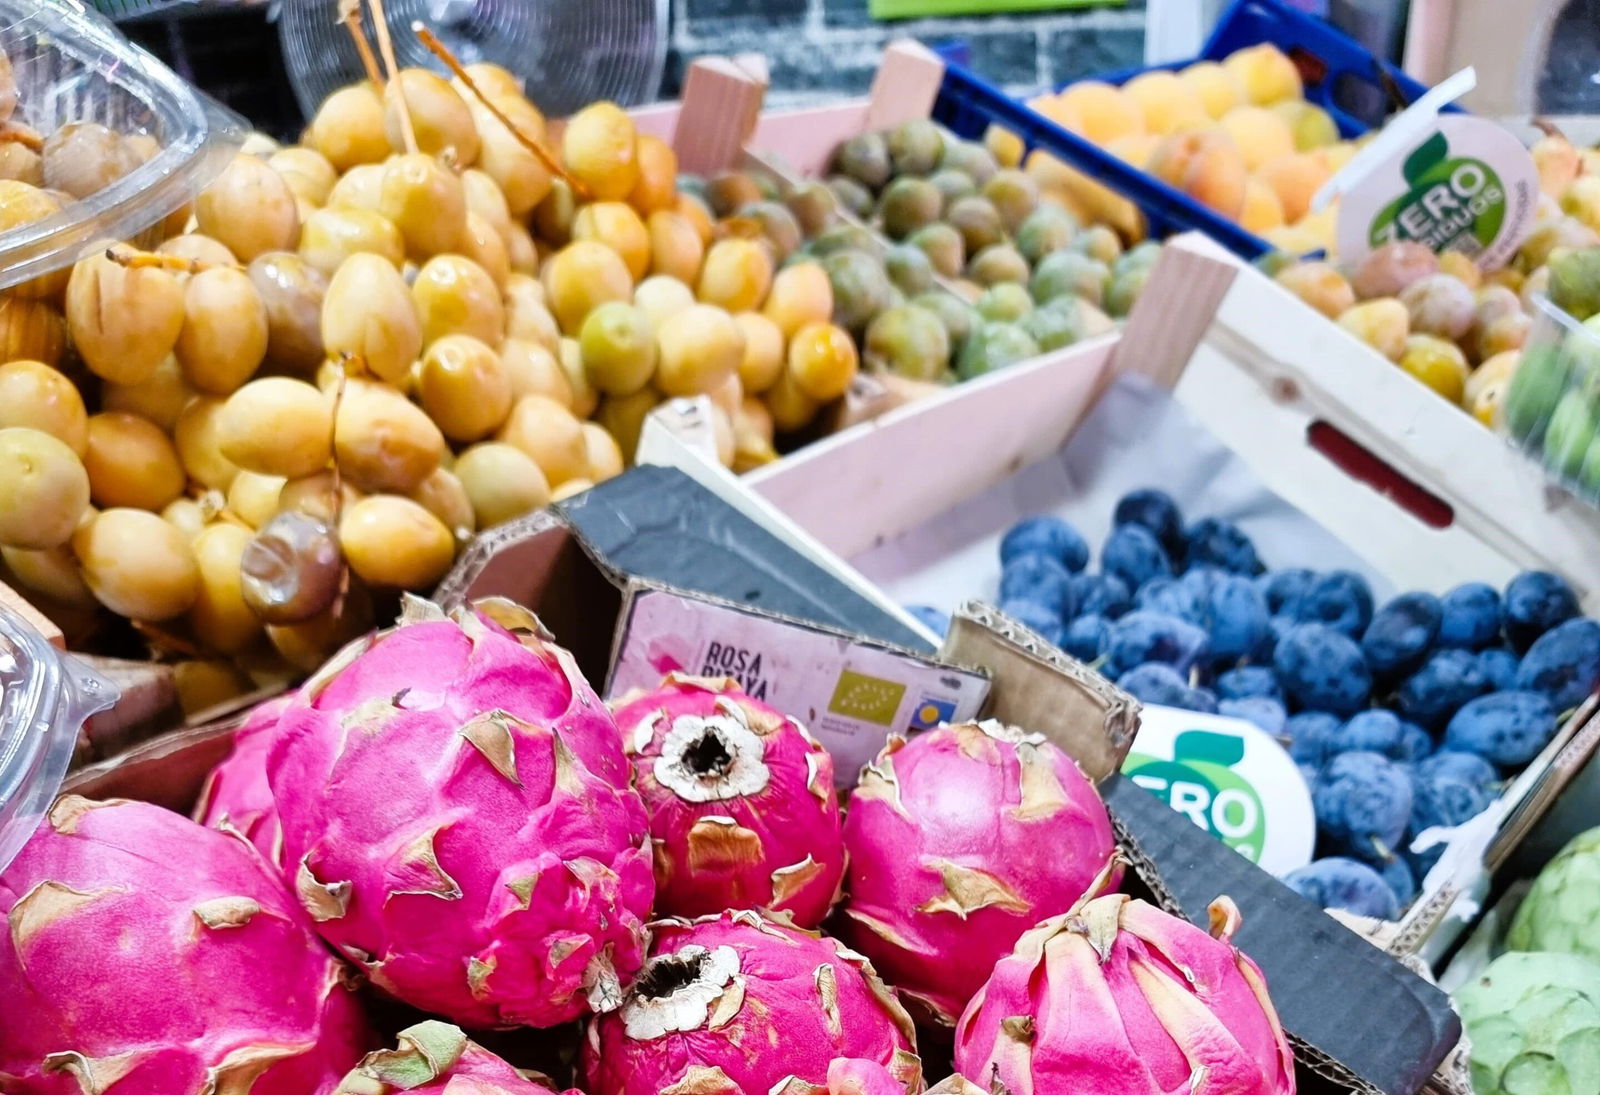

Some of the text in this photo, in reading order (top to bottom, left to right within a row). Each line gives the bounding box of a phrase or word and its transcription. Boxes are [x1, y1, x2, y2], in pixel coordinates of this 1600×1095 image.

[706, 641, 762, 677] ROSA
[701, 665, 767, 702] PYA
[1131, 774, 1258, 839] RO
